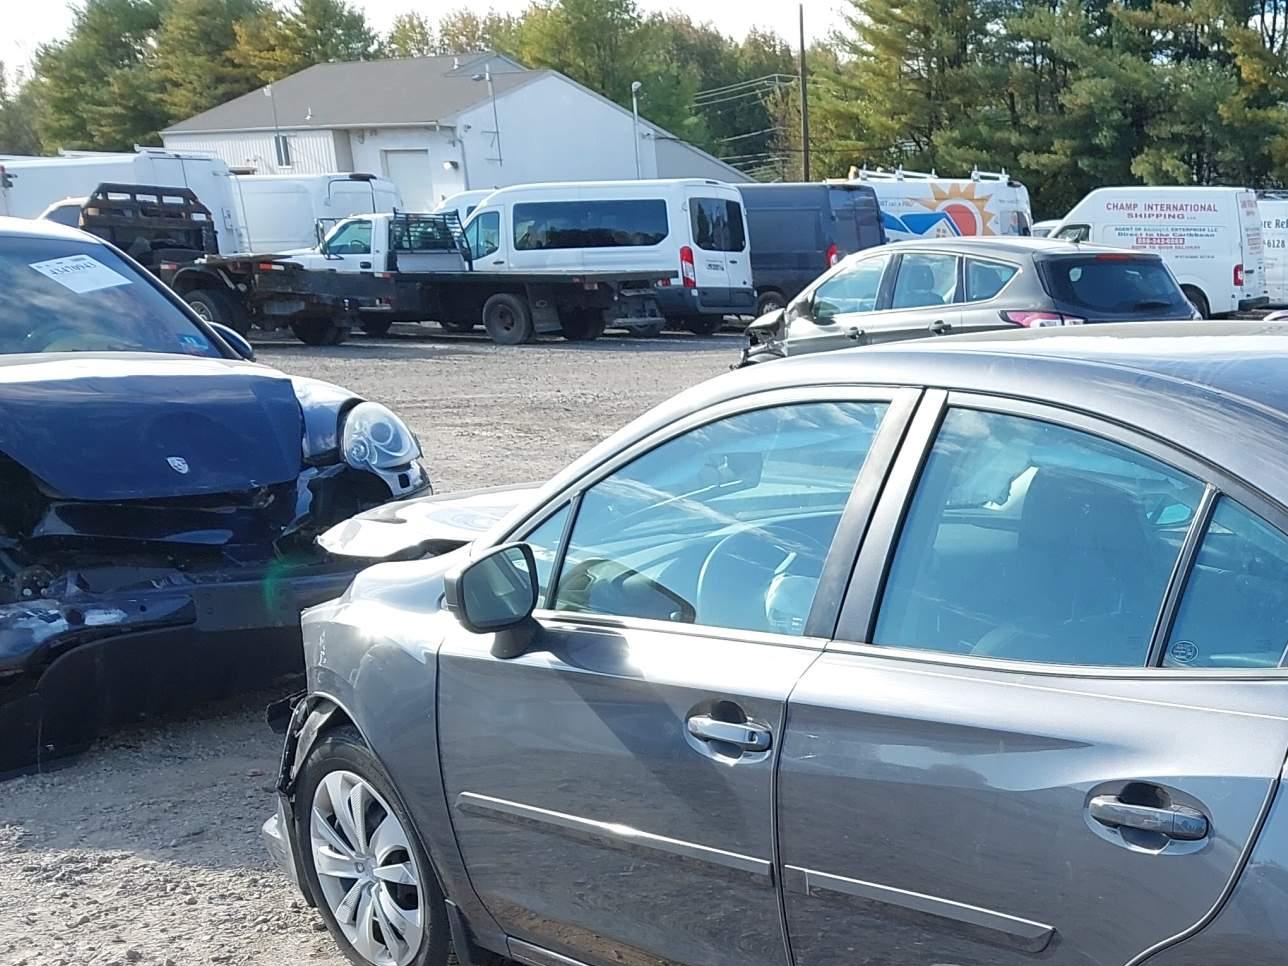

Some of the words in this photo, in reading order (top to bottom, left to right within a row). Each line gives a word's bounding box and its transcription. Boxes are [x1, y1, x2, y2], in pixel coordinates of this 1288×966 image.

[1106, 202, 1138, 211] CHAMP
[1144, 203, 1218, 213] INTERNATIONAL
[1127, 212, 1185, 220] SHIPPING
[1262, 219, 1272, 229] re
